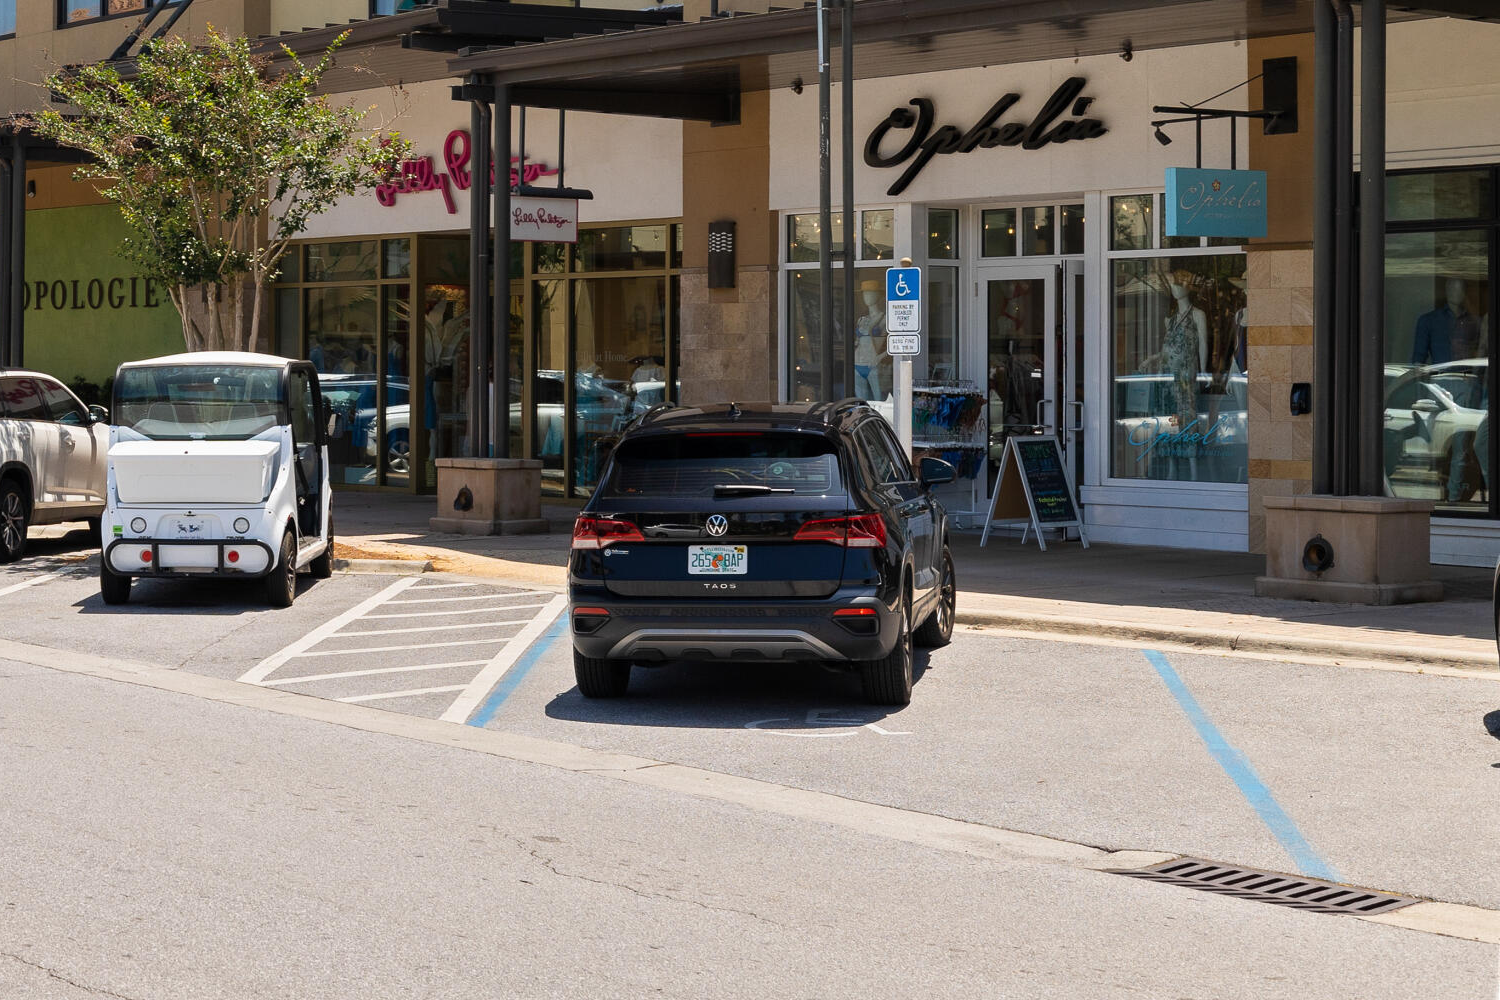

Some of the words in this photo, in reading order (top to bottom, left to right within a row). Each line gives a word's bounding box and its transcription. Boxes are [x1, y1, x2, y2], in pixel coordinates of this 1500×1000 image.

[864, 77, 1109, 196] Ophelia
[512, 207, 540, 230] Lilly
[536, 207, 573, 229] Pulitzer
[1180, 181, 1261, 225] Ophelia
[691, 553, 712, 568] 265
